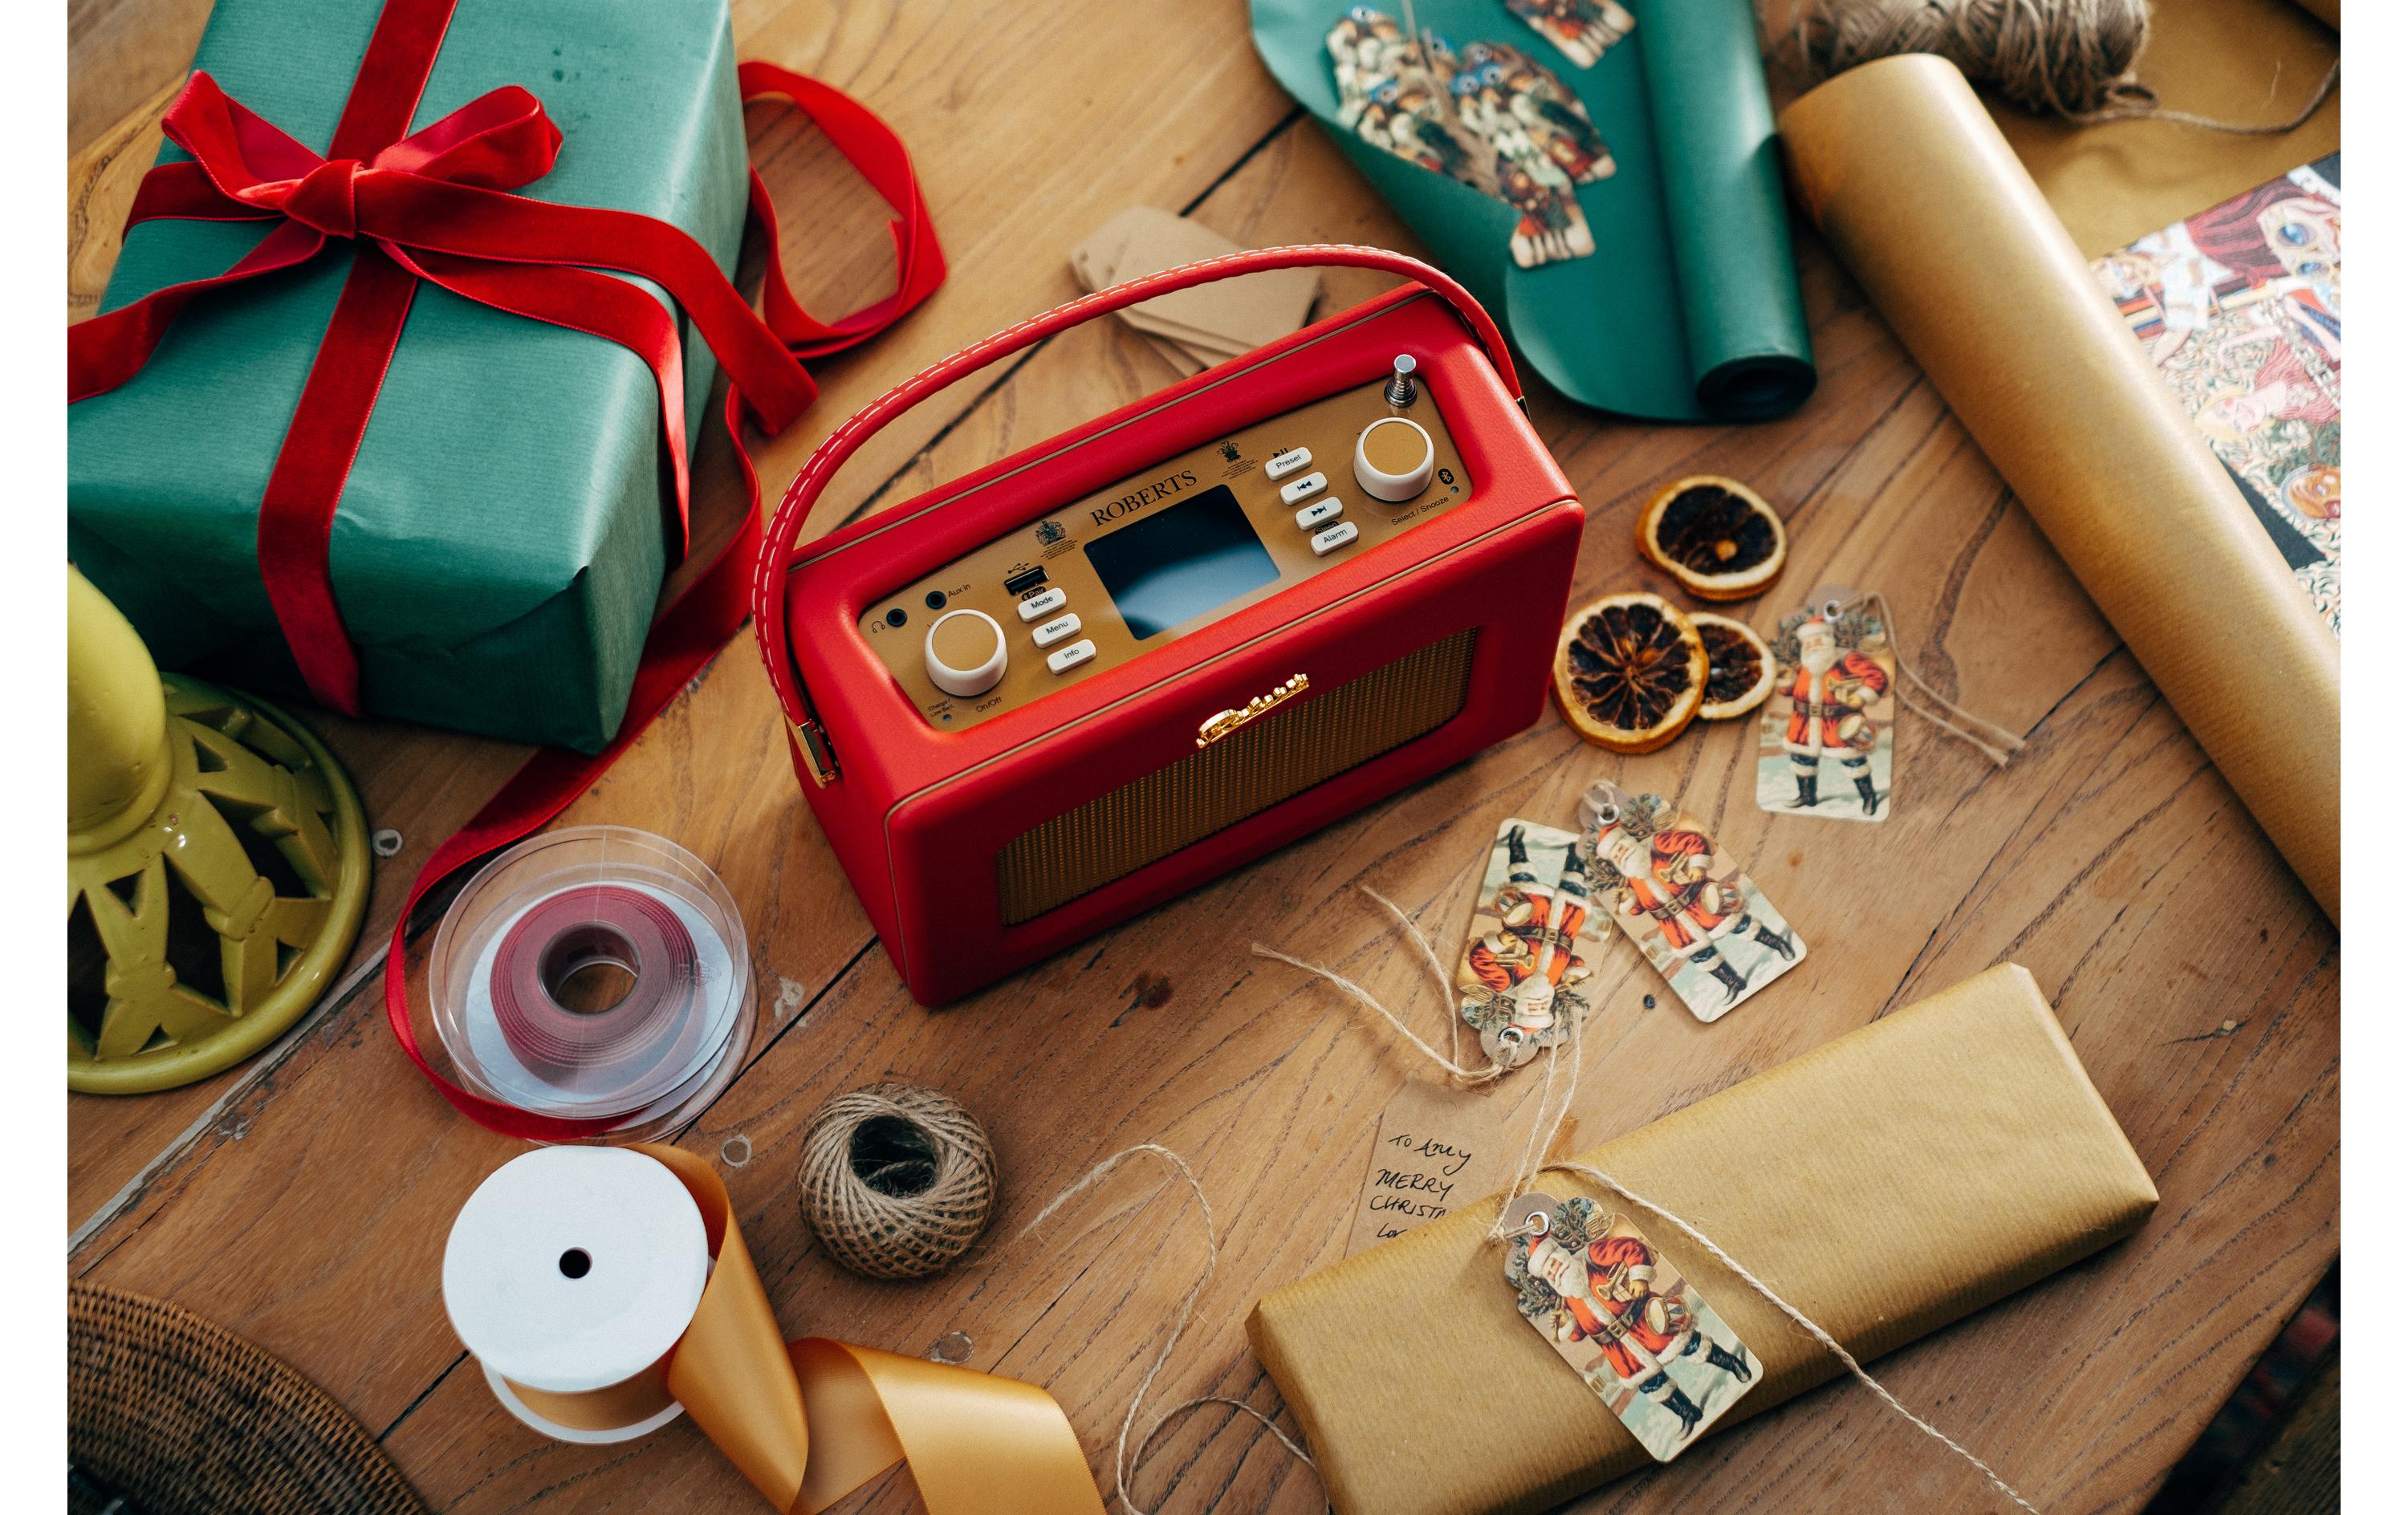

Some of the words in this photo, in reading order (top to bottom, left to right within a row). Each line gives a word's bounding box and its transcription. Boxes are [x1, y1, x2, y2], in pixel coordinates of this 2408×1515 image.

[1275, 454, 1302, 469] Preset
[1090, 470, 1197, 526] ROBERTS
[1391, 511, 1416, 526] Select
[1420, 496, 1450, 513] Snooze
[1324, 528, 1348, 544] Alarm
[948, 587, 963, 598] Aux
[963, 583, 971, 591] in
[1031, 595, 1054, 609] Mode
[1046, 621, 1068, 635] Menu
[976, 697, 1002, 713] On/Off
[1413, 1138, 1472, 1176] Amy
[1375, 1168, 1454, 1202] MERRY
